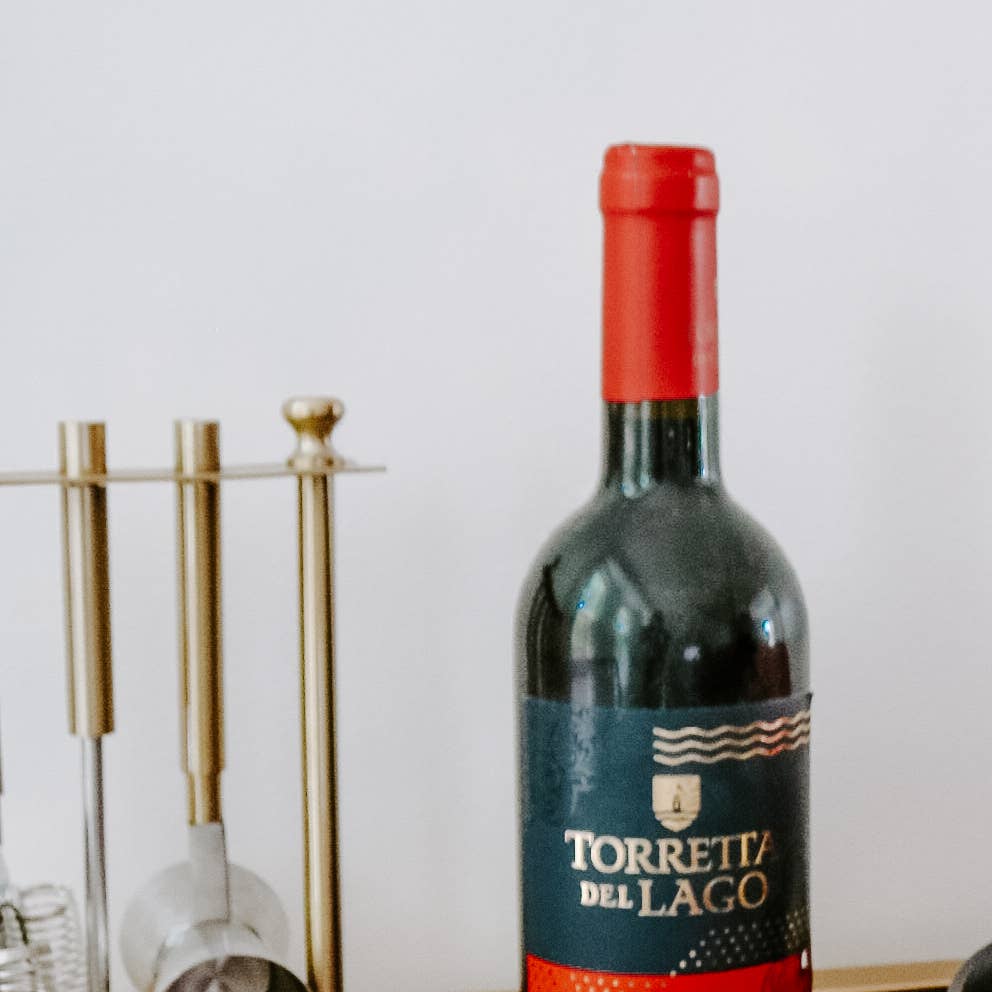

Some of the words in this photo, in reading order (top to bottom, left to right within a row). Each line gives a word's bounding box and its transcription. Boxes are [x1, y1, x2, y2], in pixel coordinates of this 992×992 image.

[564, 829, 774, 875] TORRETTA
[580, 879, 633, 909] DEL
[637, 870, 769, 917] LAGO
